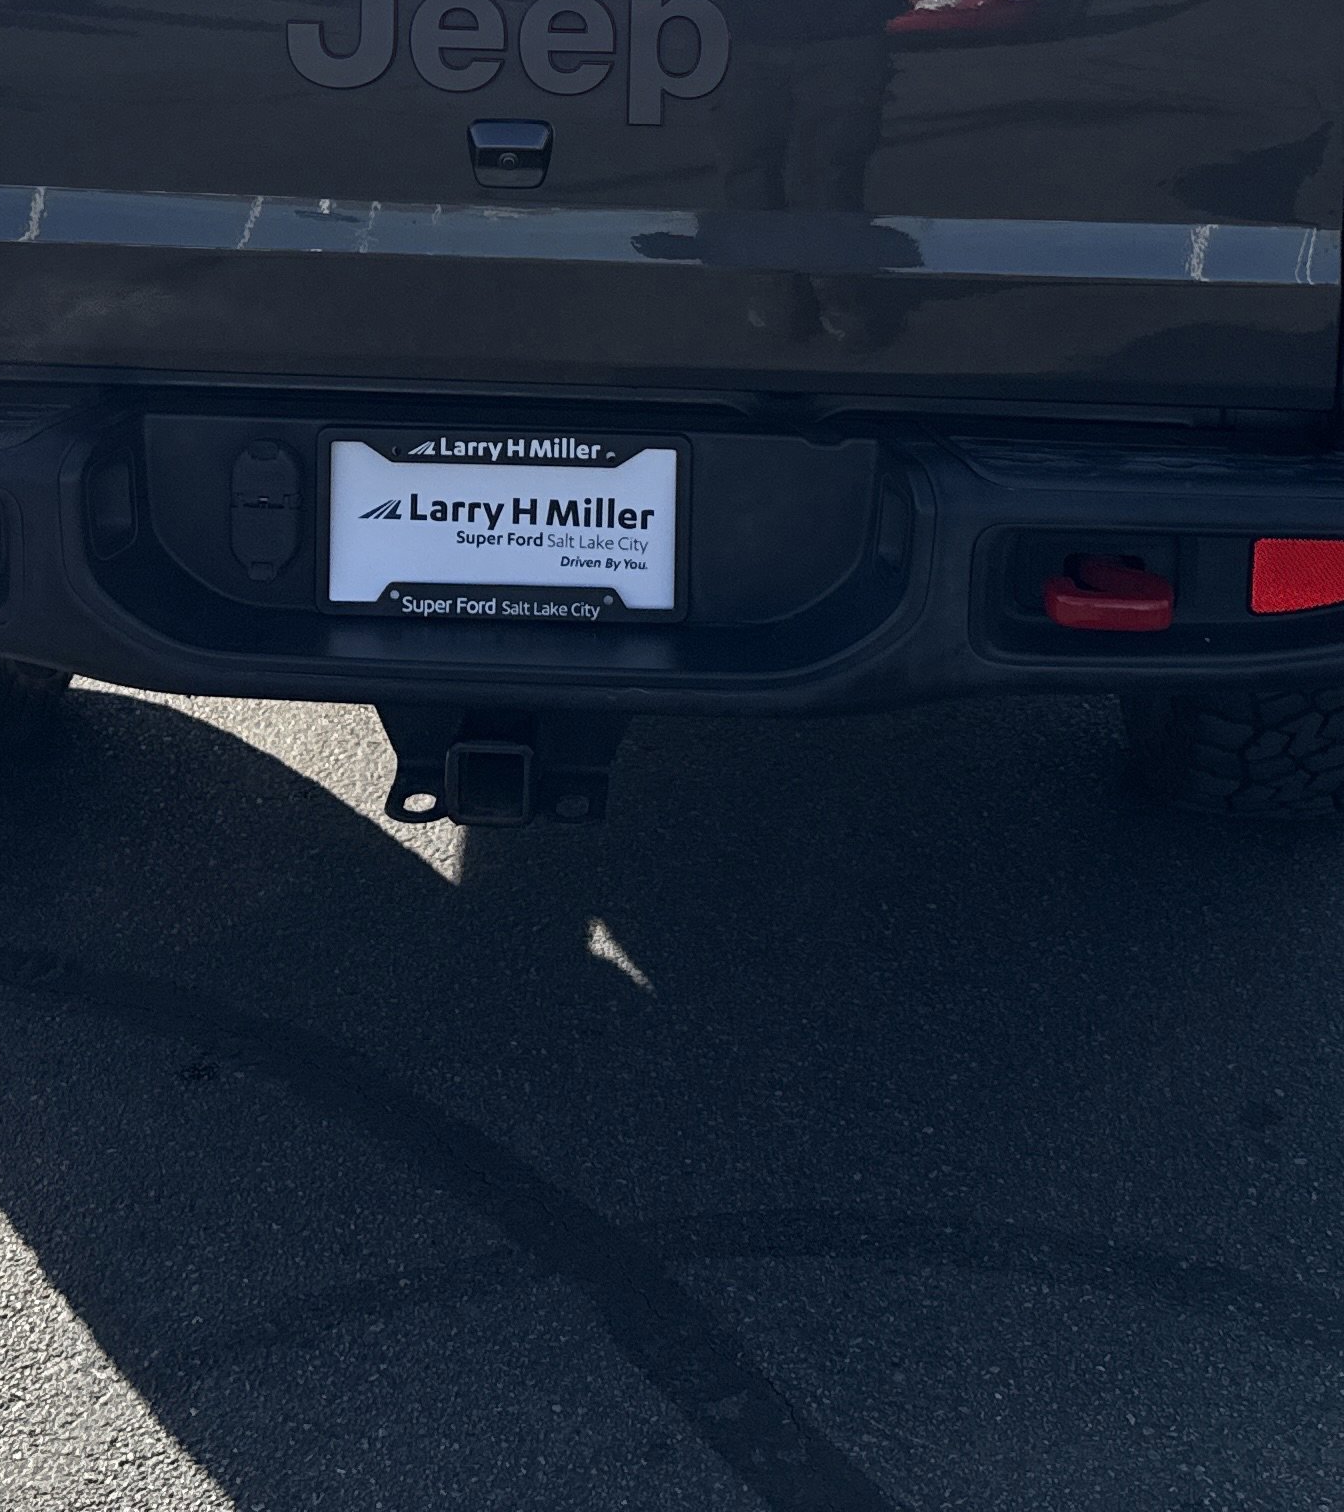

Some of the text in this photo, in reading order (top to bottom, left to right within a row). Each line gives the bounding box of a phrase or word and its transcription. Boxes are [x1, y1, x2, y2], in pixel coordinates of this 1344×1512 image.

[440, 437, 601, 461] Larry H Miller
[409, 493, 655, 530] Larry H Miller
[456, 530, 649, 554] Super Ford Salt Lake City
[560, 556, 602, 569] Driven
[605, 558, 621, 571] By
[402, 596, 601, 620] Super Ford Salt Lake City
